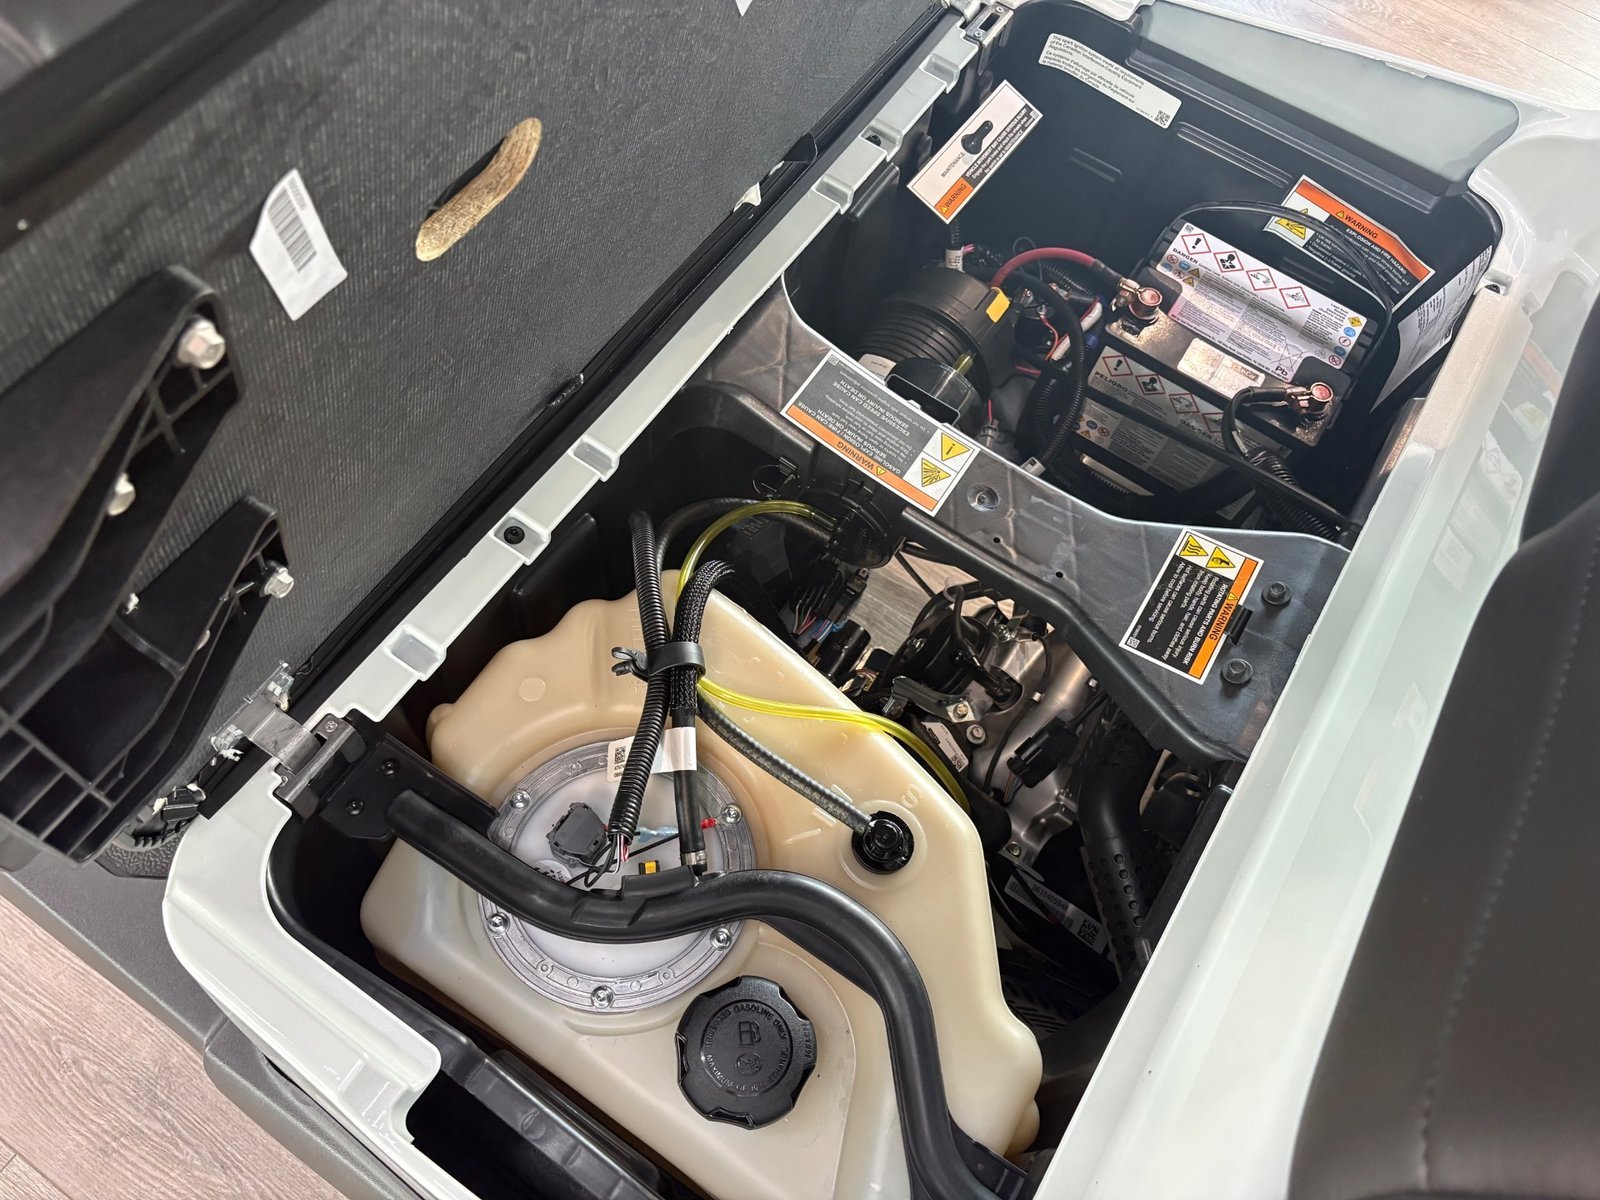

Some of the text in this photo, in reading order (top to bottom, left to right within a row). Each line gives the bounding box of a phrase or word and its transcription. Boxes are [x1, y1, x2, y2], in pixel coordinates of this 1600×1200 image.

[964, 107, 1027, 177] VEHICLE MOVEMENT MAY CAUSE SERIOUS INJURY
[940, 151, 964, 177] MAINTENANCE
[943, 182, 966, 207] WARNING
[1344, 214, 1378, 239] WARNING
[1172, 247, 1198, 264] DANGER
[1345, 228, 1371, 246] EXPLOSION
[1370, 244, 1381, 252] AND
[1380, 250, 1391, 260] FIRE
[1390, 257, 1407, 274] HAZARD
[1274, 365, 1288, 376] Pb
[1093, 370, 1128, 392] PELIGRO
[796, 400, 816, 416] CAUSE
[832, 380, 910, 436] EXCESSIVE SPEED CAN CAUSE
[839, 379, 908, 429] SERIOUS INJURY OR DEATH
[815, 413, 828, 424] CAN
[827, 422, 840, 433] FIRE
[816, 408, 886, 458] SERIOUS INJURY OR DEATH
[842, 432, 873, 456] EXPLOSION
[836, 440, 874, 469] WARNING
[871, 453, 901, 474] GASOLINE
[1175, 561, 1185, 574] Allow
[1184, 564, 1192, 573] Hot
[1195, 569, 1204, 581] from
[1167, 578, 1176, 588] cool
[1174, 572, 1188, 592] surfaces
[1200, 572, 1211, 585] Keep
[1204, 575, 1219, 595] Rotating
[1159, 587, 1171, 603] before
[1185, 579, 1198, 597] rotating
[1162, 599, 1173, 614] cause
[1198, 593, 1209, 606] parts
[1154, 612, 1167, 630] serious
[1177, 621, 1186, 632] and
[1182, 583, 1227, 665] ROTATING PARTS AND BURN RISK
[1187, 614, 1198, 629] cause
[1208, 601, 1233, 641] WARNING
[1168, 630, 1181, 648] clothes
[1179, 628, 1191, 646] serious
[1160, 646, 1171, 660] away
[733, 1003, 773, 1020] GASOLINE
[773, 1018, 787, 1040] ONLY
[706, 1054, 733, 1087] MAXIMUM
